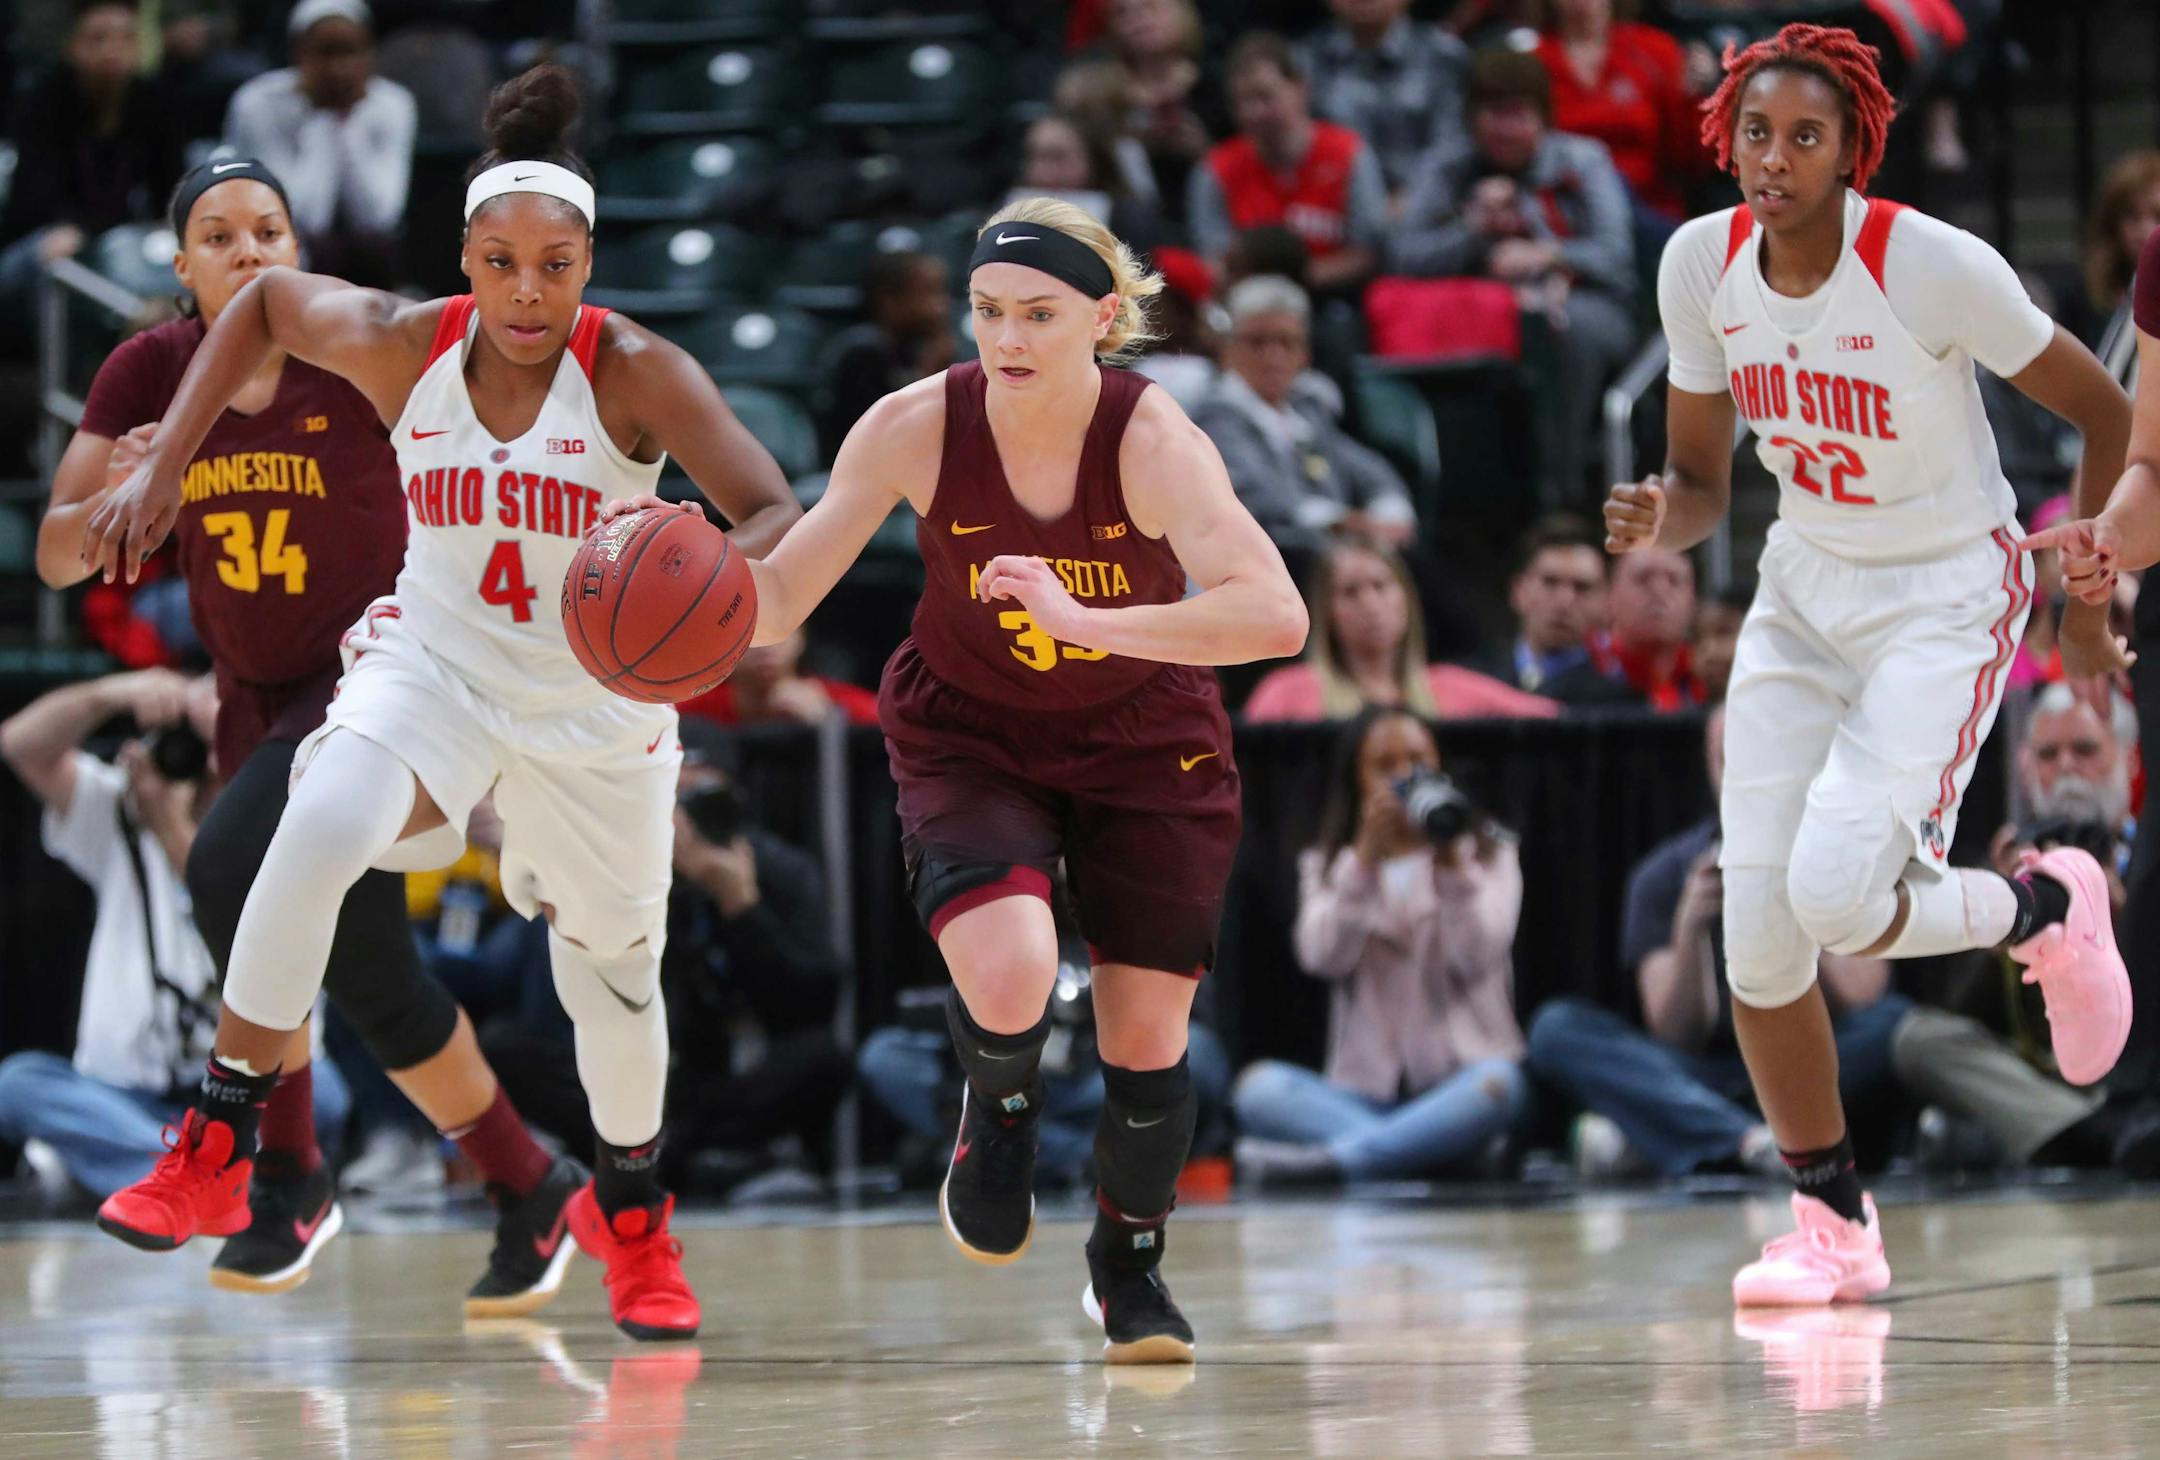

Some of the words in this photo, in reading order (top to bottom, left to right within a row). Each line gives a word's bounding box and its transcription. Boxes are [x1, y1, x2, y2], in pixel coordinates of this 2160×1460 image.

[1731, 363, 1789, 420] OHIO
[1796, 368, 1898, 441] STATE
[180, 452, 327, 507] MINNESOTA
[408, 466, 484, 527] OHIO
[497, 470, 603, 540] STATE
[1769, 435, 1876, 504] 22
[202, 508, 308, 595] 34
[479, 539, 538, 623] 4
